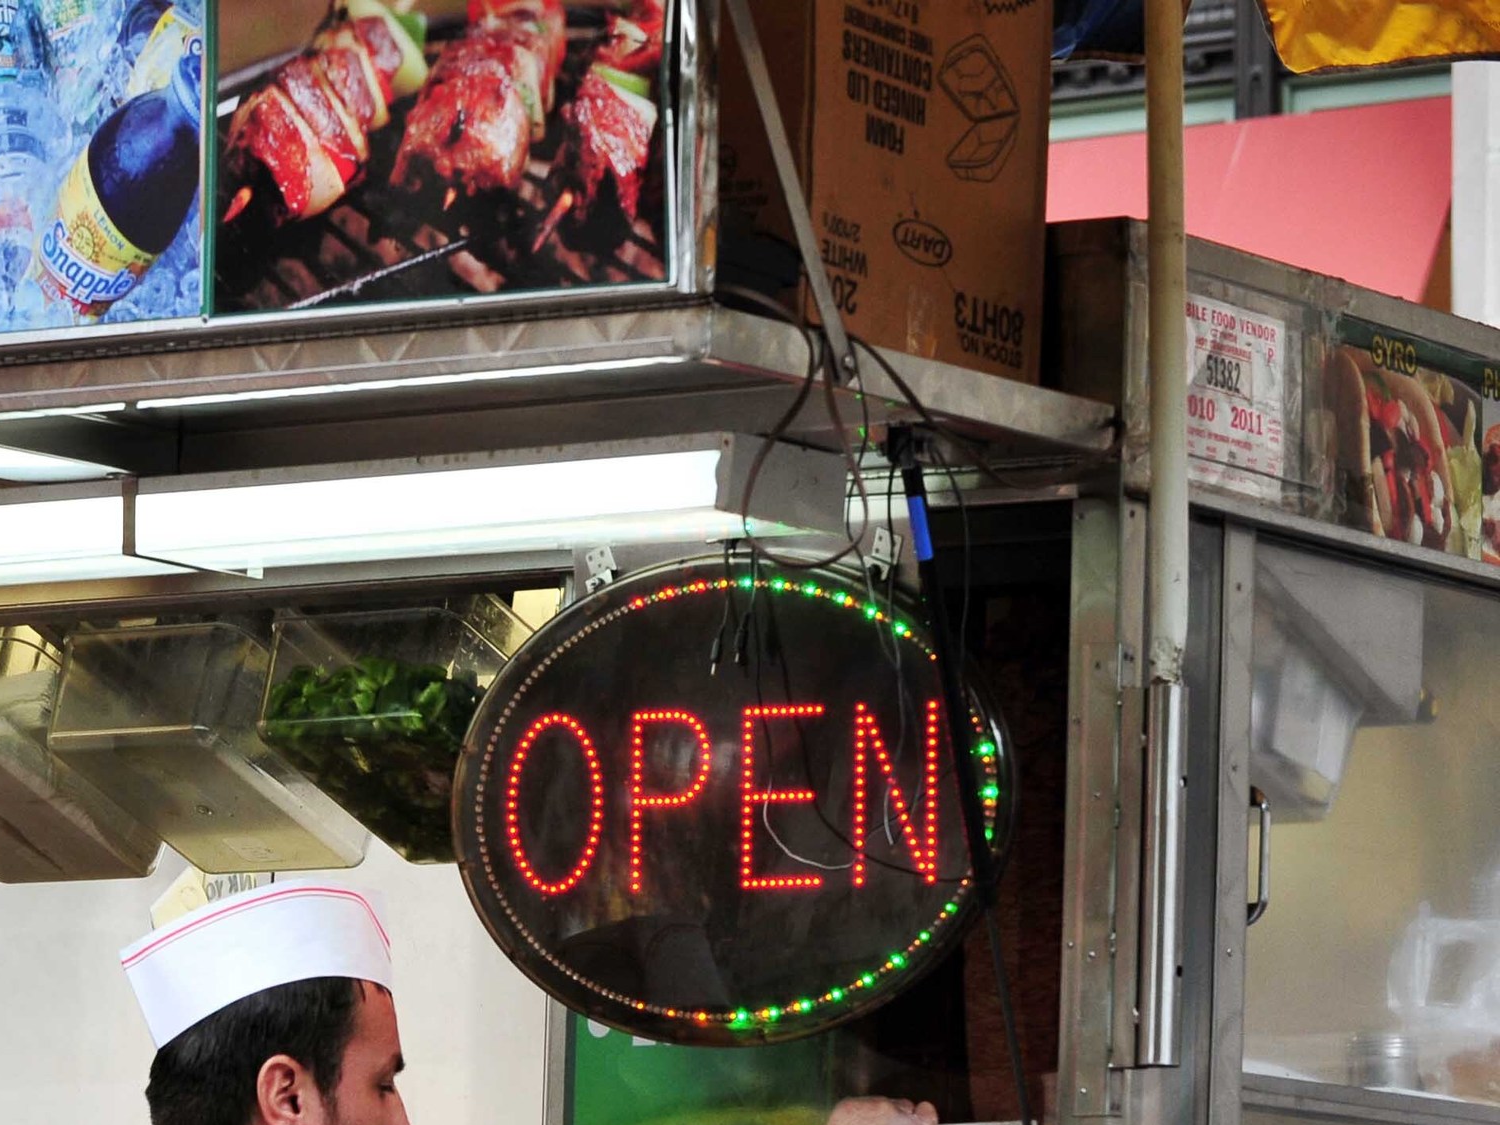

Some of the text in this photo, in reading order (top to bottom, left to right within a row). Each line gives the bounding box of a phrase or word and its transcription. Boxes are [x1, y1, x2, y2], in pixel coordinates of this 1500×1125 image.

[842, 29, 933, 91] CONTAINERS
[846, 70, 926, 127] HINGED LID
[865, 114, 906, 155] FOAM
[43, 219, 136, 301] Snapple
[821, 239, 868, 278] WHITE
[900, 228, 946, 260] DART
[954, 291, 1025, 346] 80HT3
[1186, 301, 1207, 322] BILE
[1211, 307, 1237, 330] FOOD
[1239, 318, 1277, 343] VENDOR
[982, 340, 1024, 370] STOCK
[1206, 353, 1242, 395] 51382
[1370, 333, 1419, 377] GYRO
[1187, 394, 1216, 423] 010
[1230, 405, 1264, 436] 2011
[505, 698, 941, 896] OPEN
